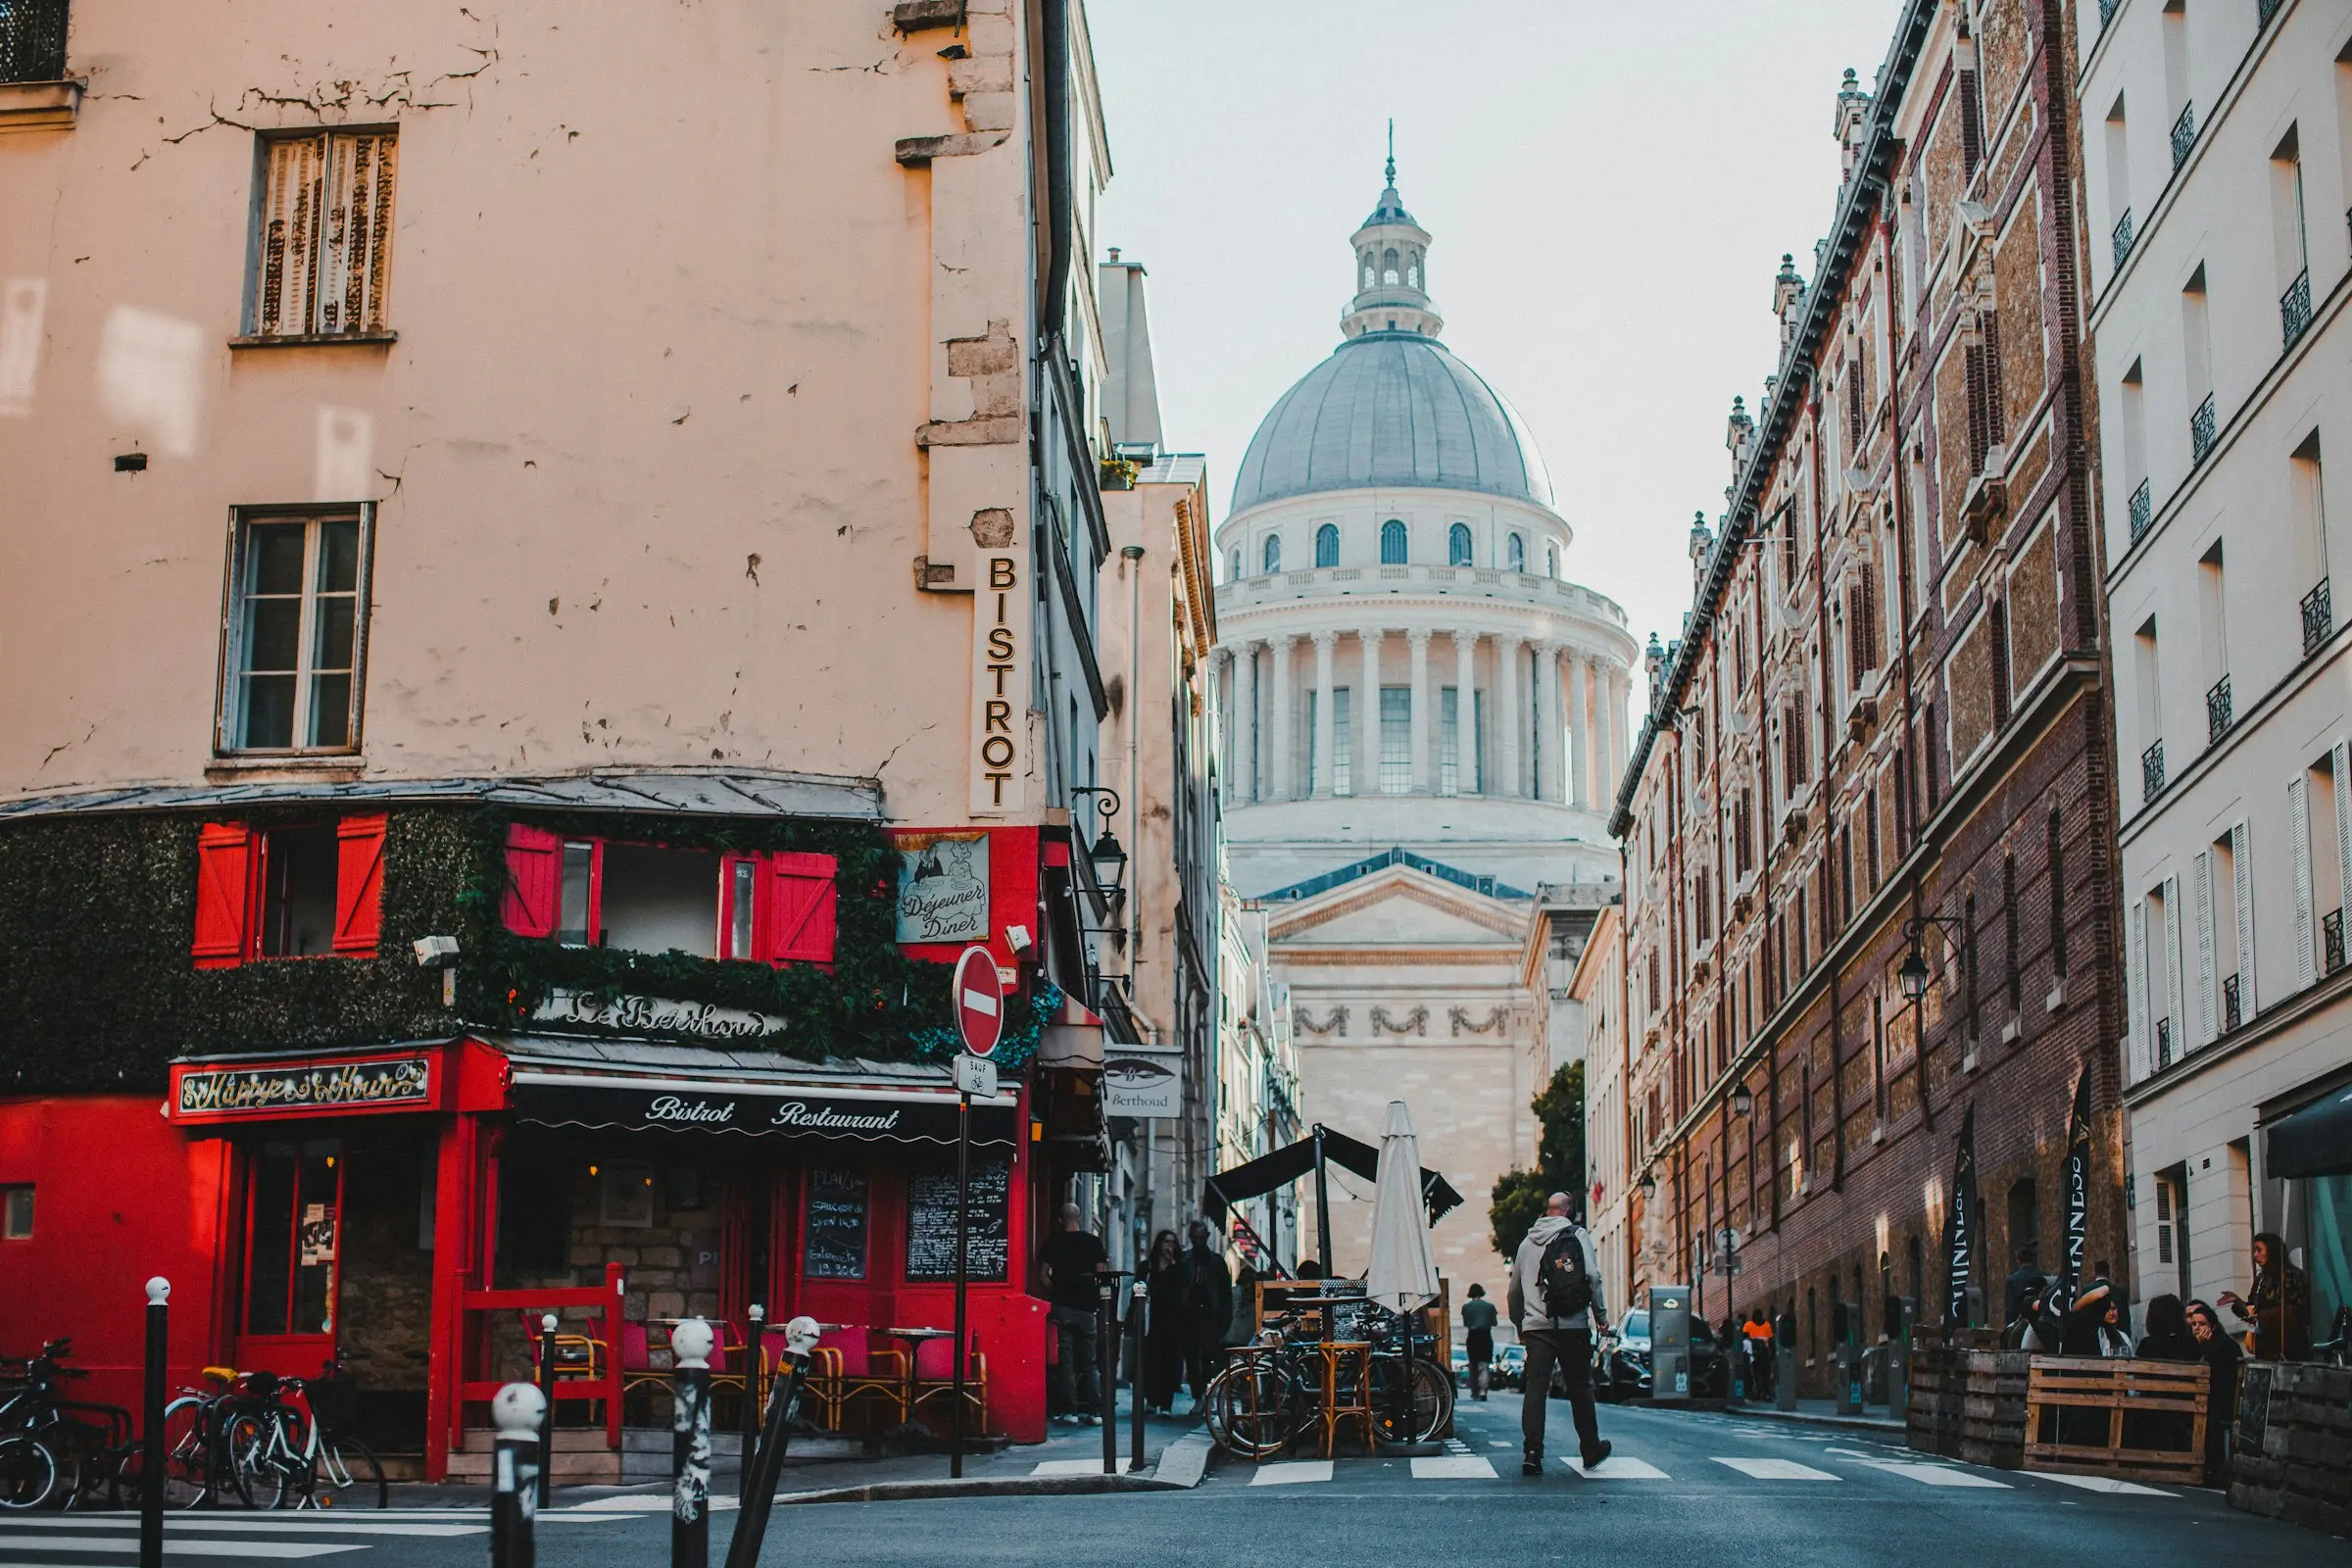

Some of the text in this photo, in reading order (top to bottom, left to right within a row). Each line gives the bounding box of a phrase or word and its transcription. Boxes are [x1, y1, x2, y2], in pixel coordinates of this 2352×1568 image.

[982, 558, 1016, 806] BISTROT
[903, 885, 985, 920] Déjeuner
[566, 992, 766, 1037] Le Berthoud
[970, 1060, 986, 1073] SAUF
[645, 1096, 900, 1129] Bistrot Restaurant
[1112, 1094, 1168, 1107] Berthoud
